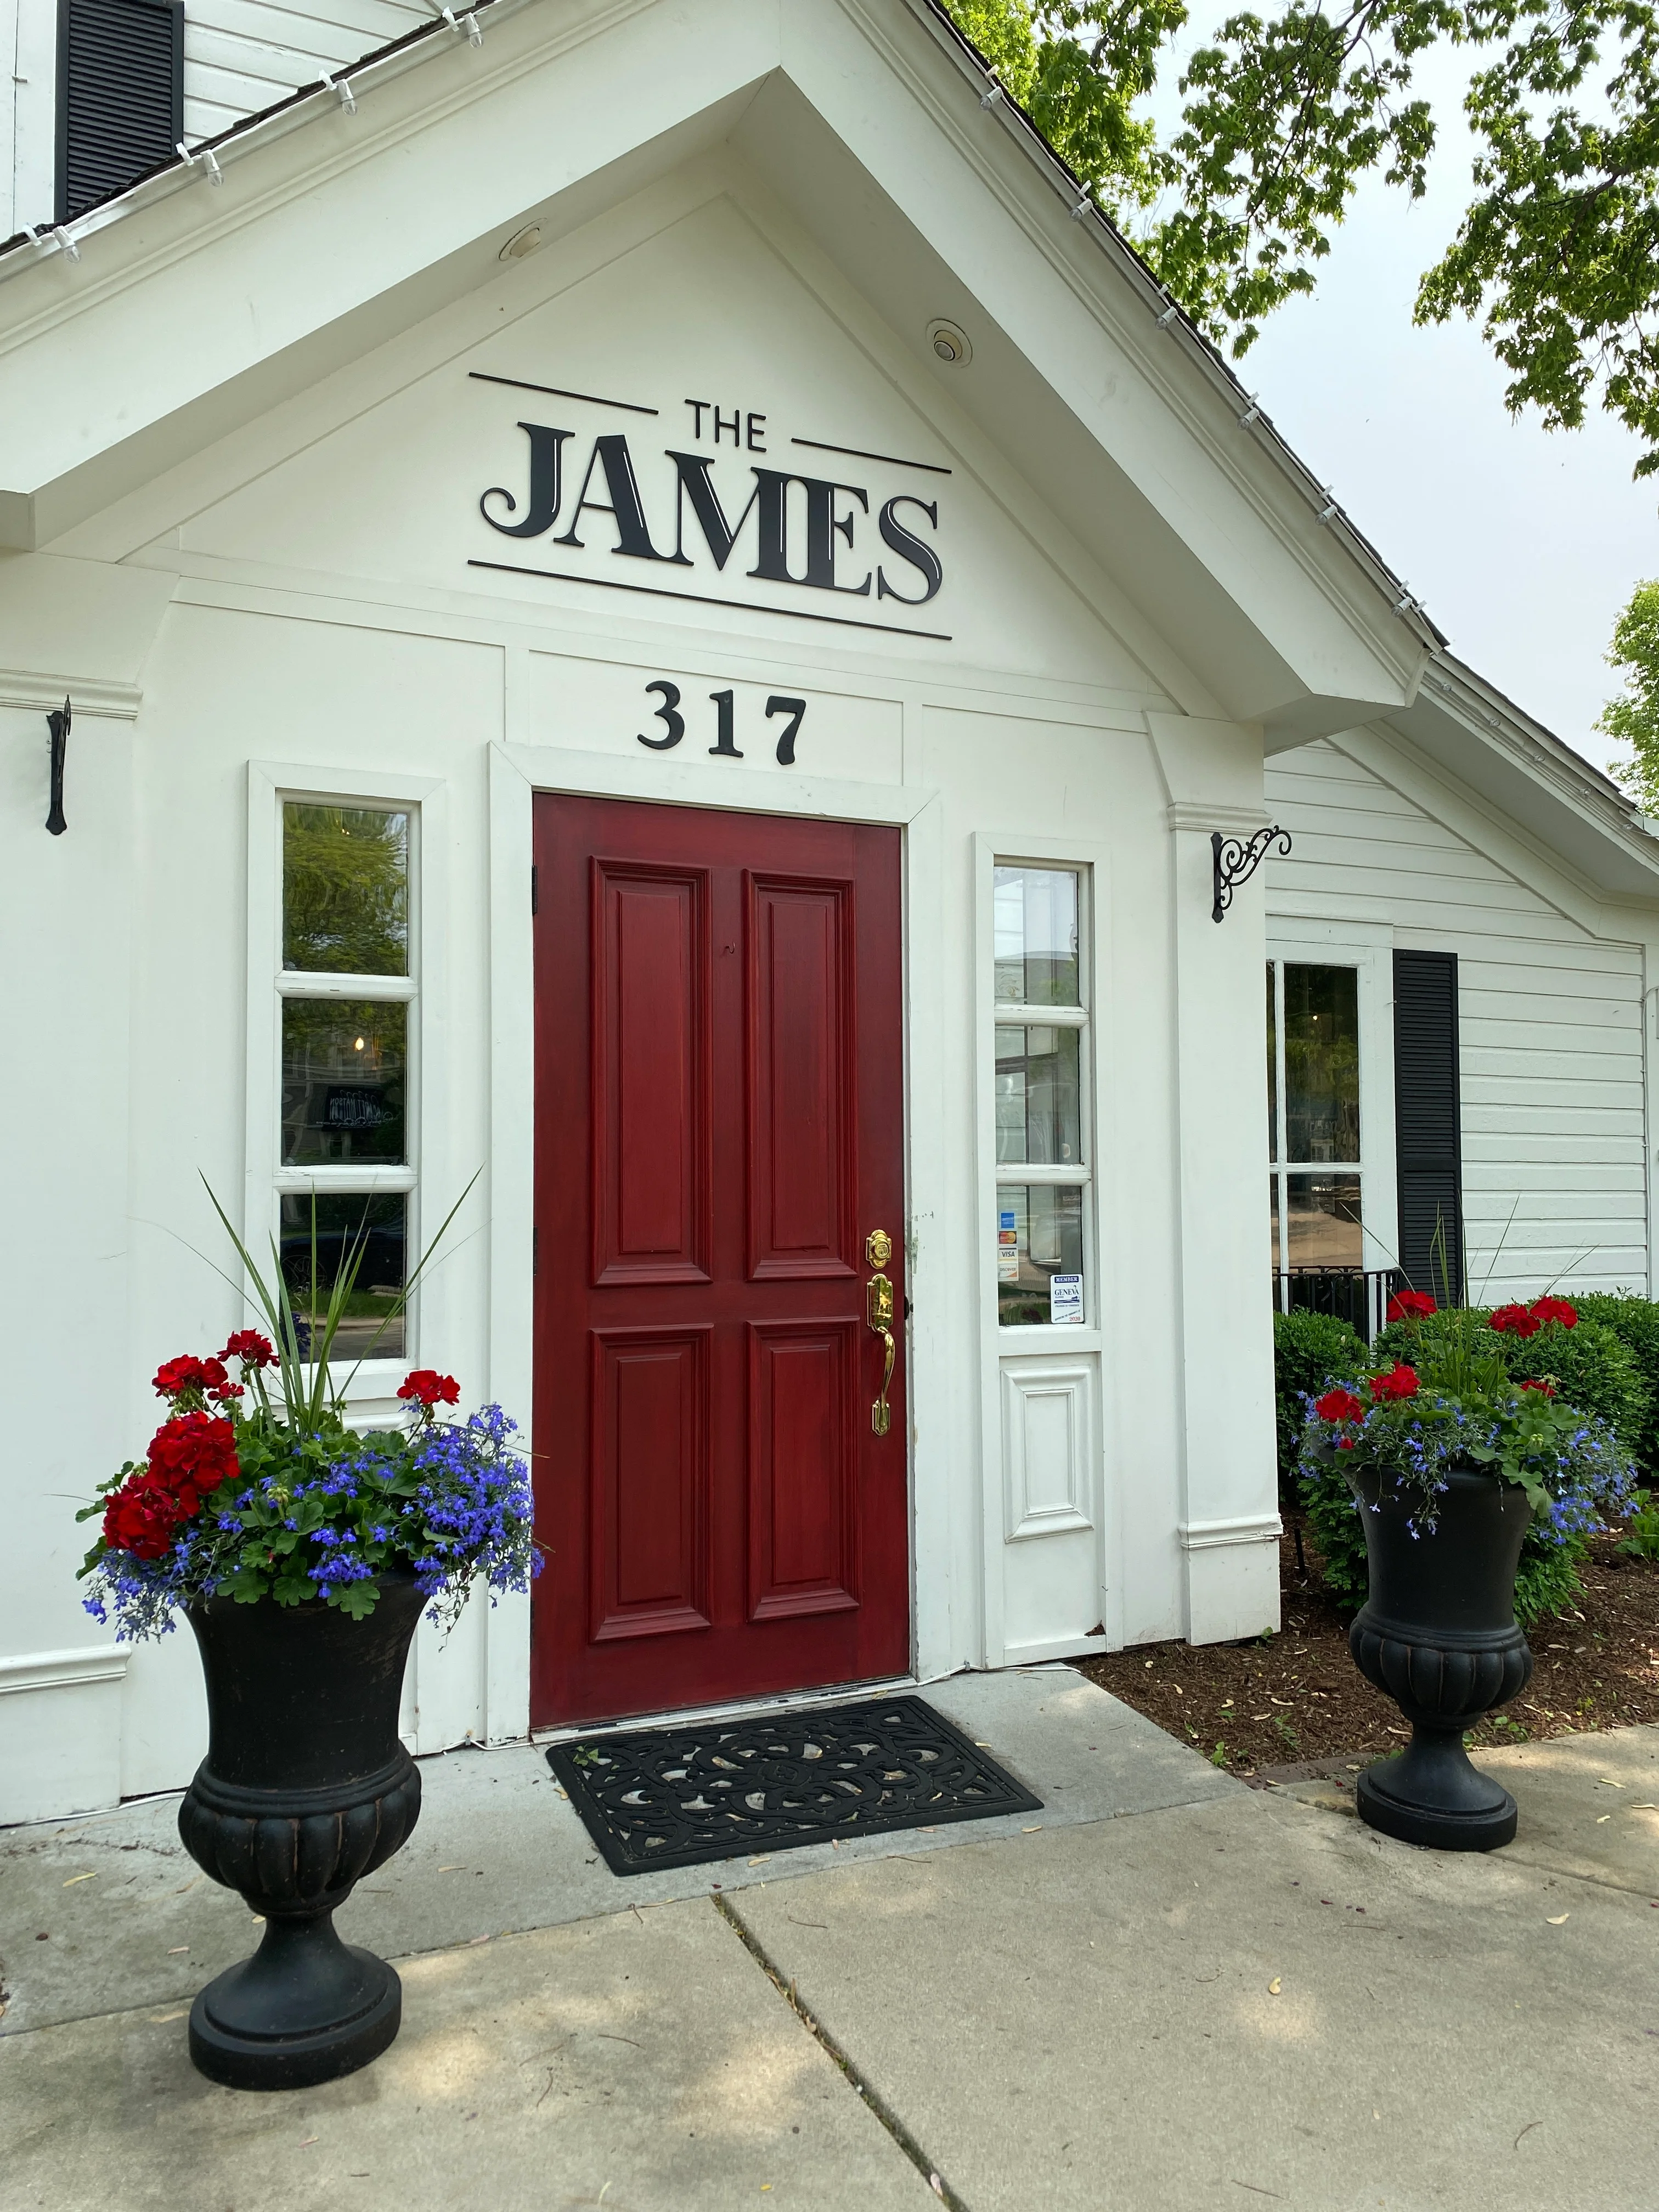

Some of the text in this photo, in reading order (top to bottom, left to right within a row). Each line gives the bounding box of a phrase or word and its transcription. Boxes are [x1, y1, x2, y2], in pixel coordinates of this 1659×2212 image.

[684, 399, 767, 453] THE
[480, 421, 943, 605] JAMES
[637, 680, 806, 766] 317
[1054, 1287, 1079, 1296] GENEVA
